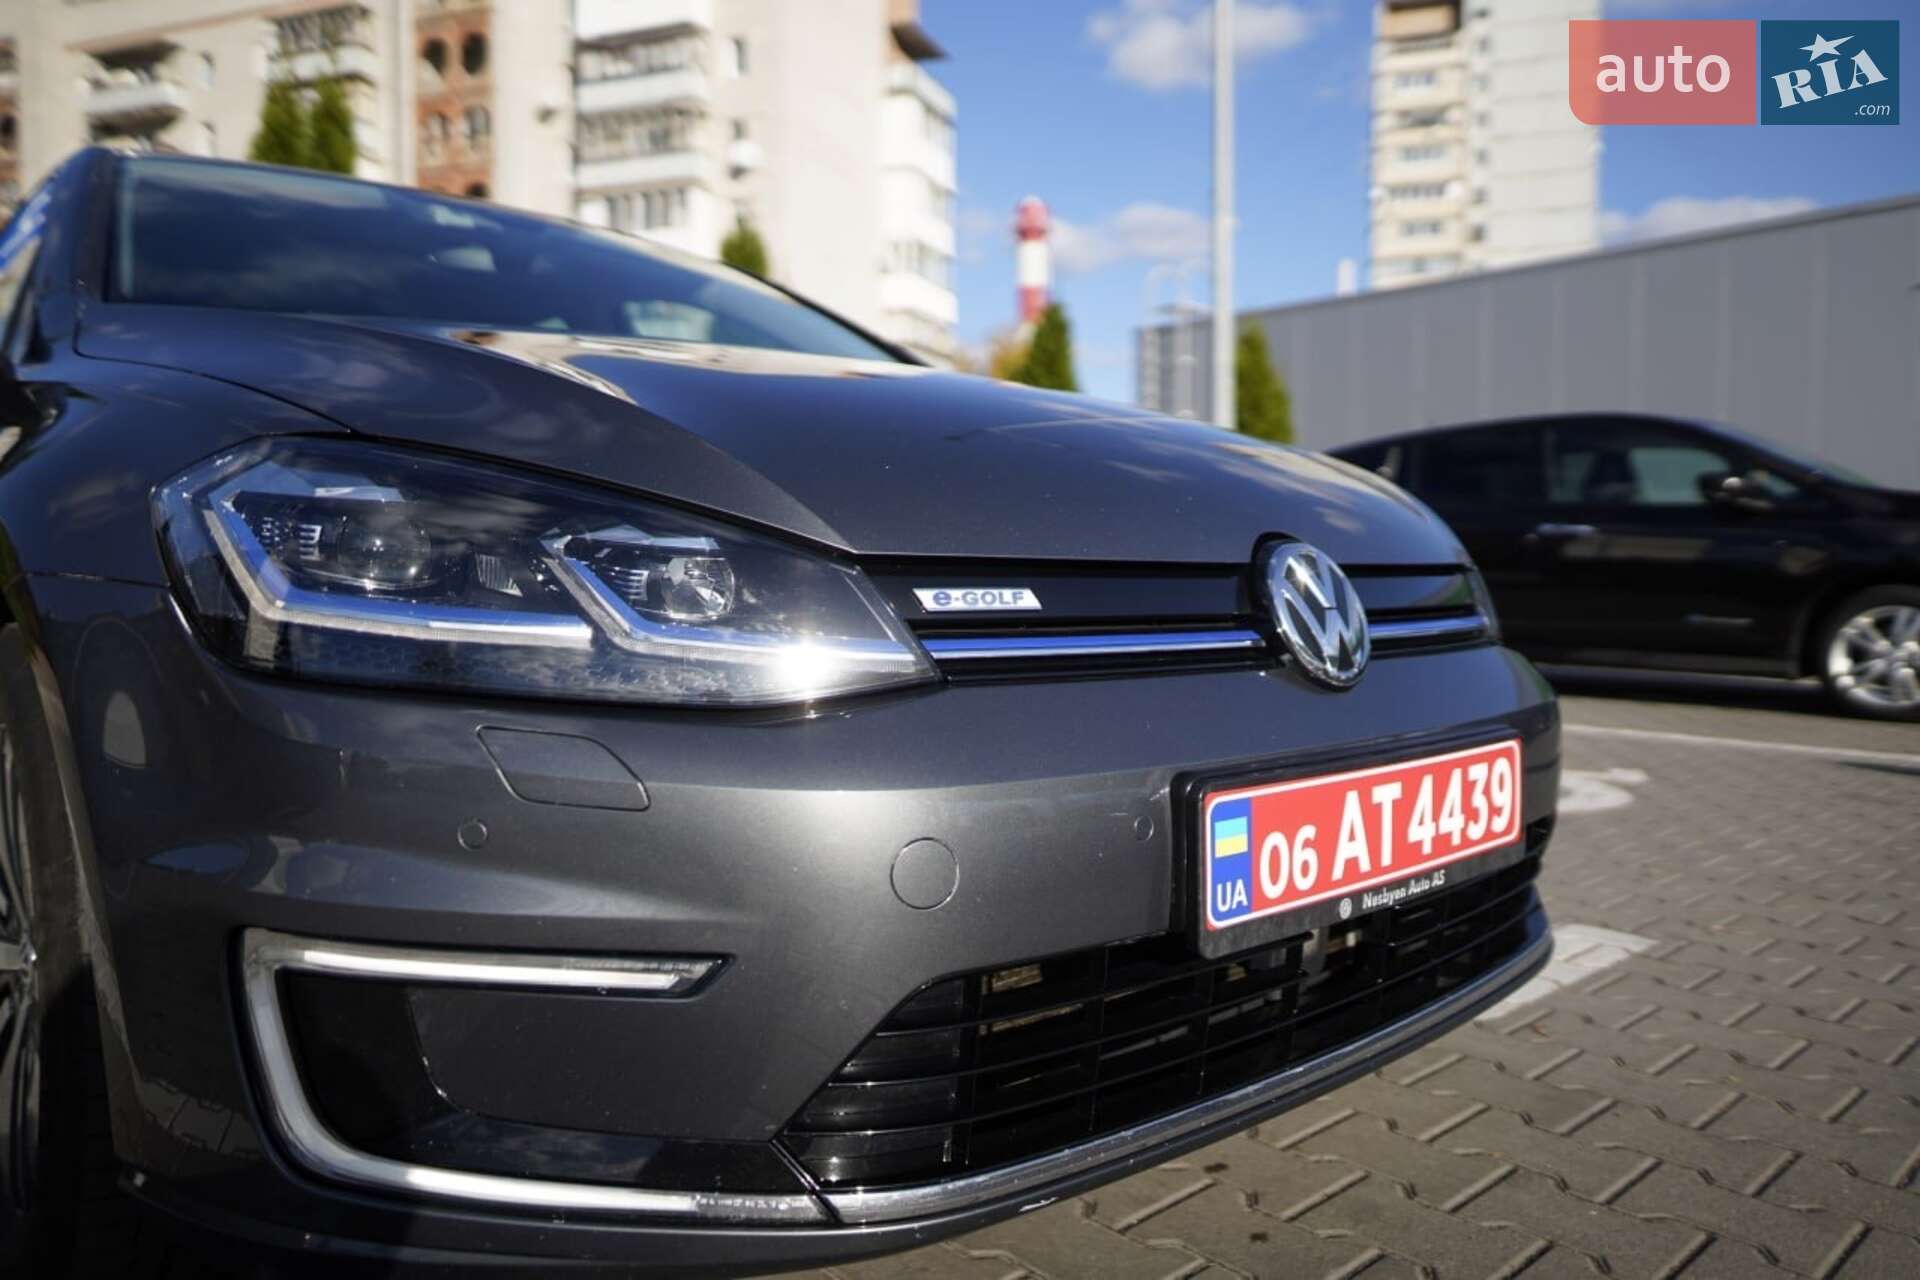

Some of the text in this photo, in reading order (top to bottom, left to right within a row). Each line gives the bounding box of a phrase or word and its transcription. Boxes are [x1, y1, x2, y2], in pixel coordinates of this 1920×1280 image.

[932, 591, 1024, 606] e-GOLF
[1259, 757, 1513, 899] 06 AT 4439
[1216, 878, 1248, 912] UA
[1408, 878, 1430, 896] Auto
[1432, 869, 1445, 887] AS
